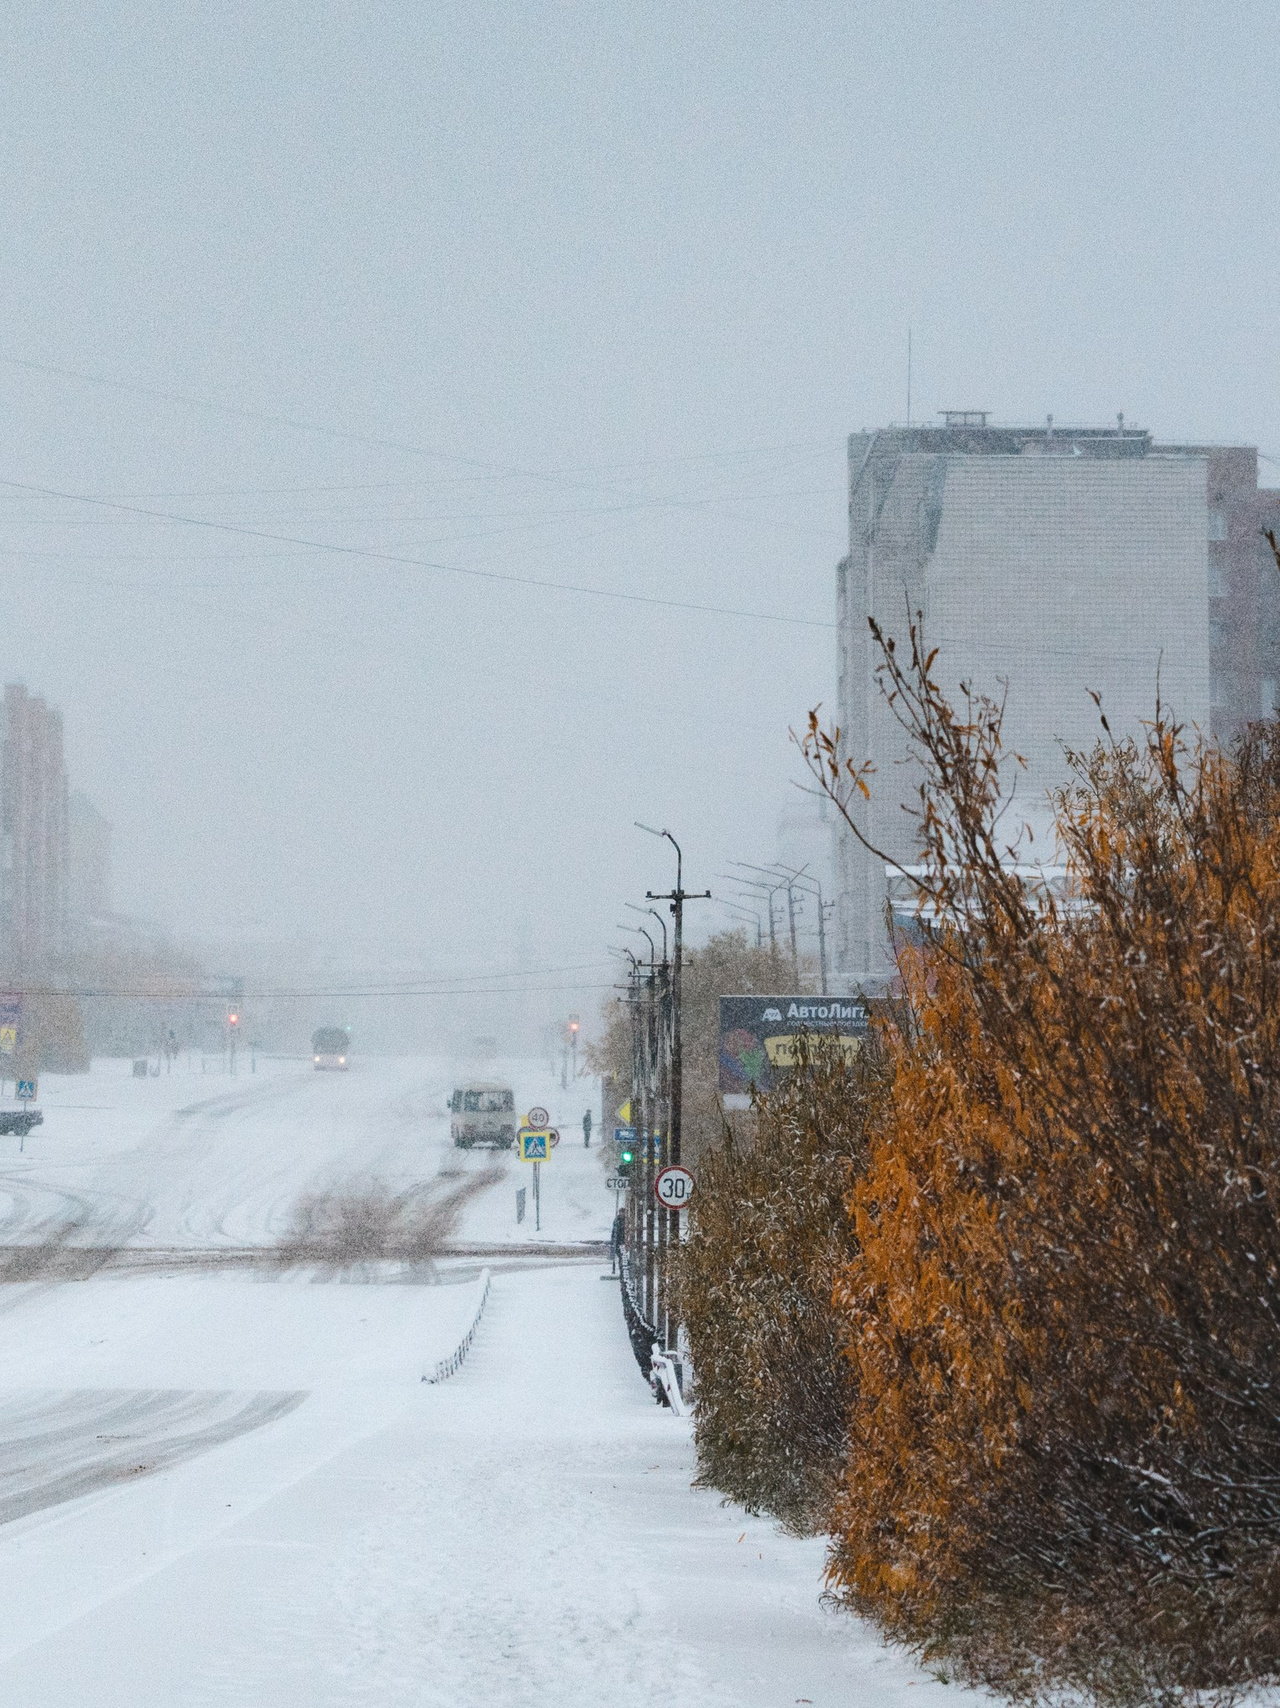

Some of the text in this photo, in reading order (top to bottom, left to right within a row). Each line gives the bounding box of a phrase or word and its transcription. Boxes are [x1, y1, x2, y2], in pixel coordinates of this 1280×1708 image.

[787, 1003, 869, 1018] АвтоЛига
[532, 1113, 545, 1123] 40
[662, 1178, 685, 1198] 30
